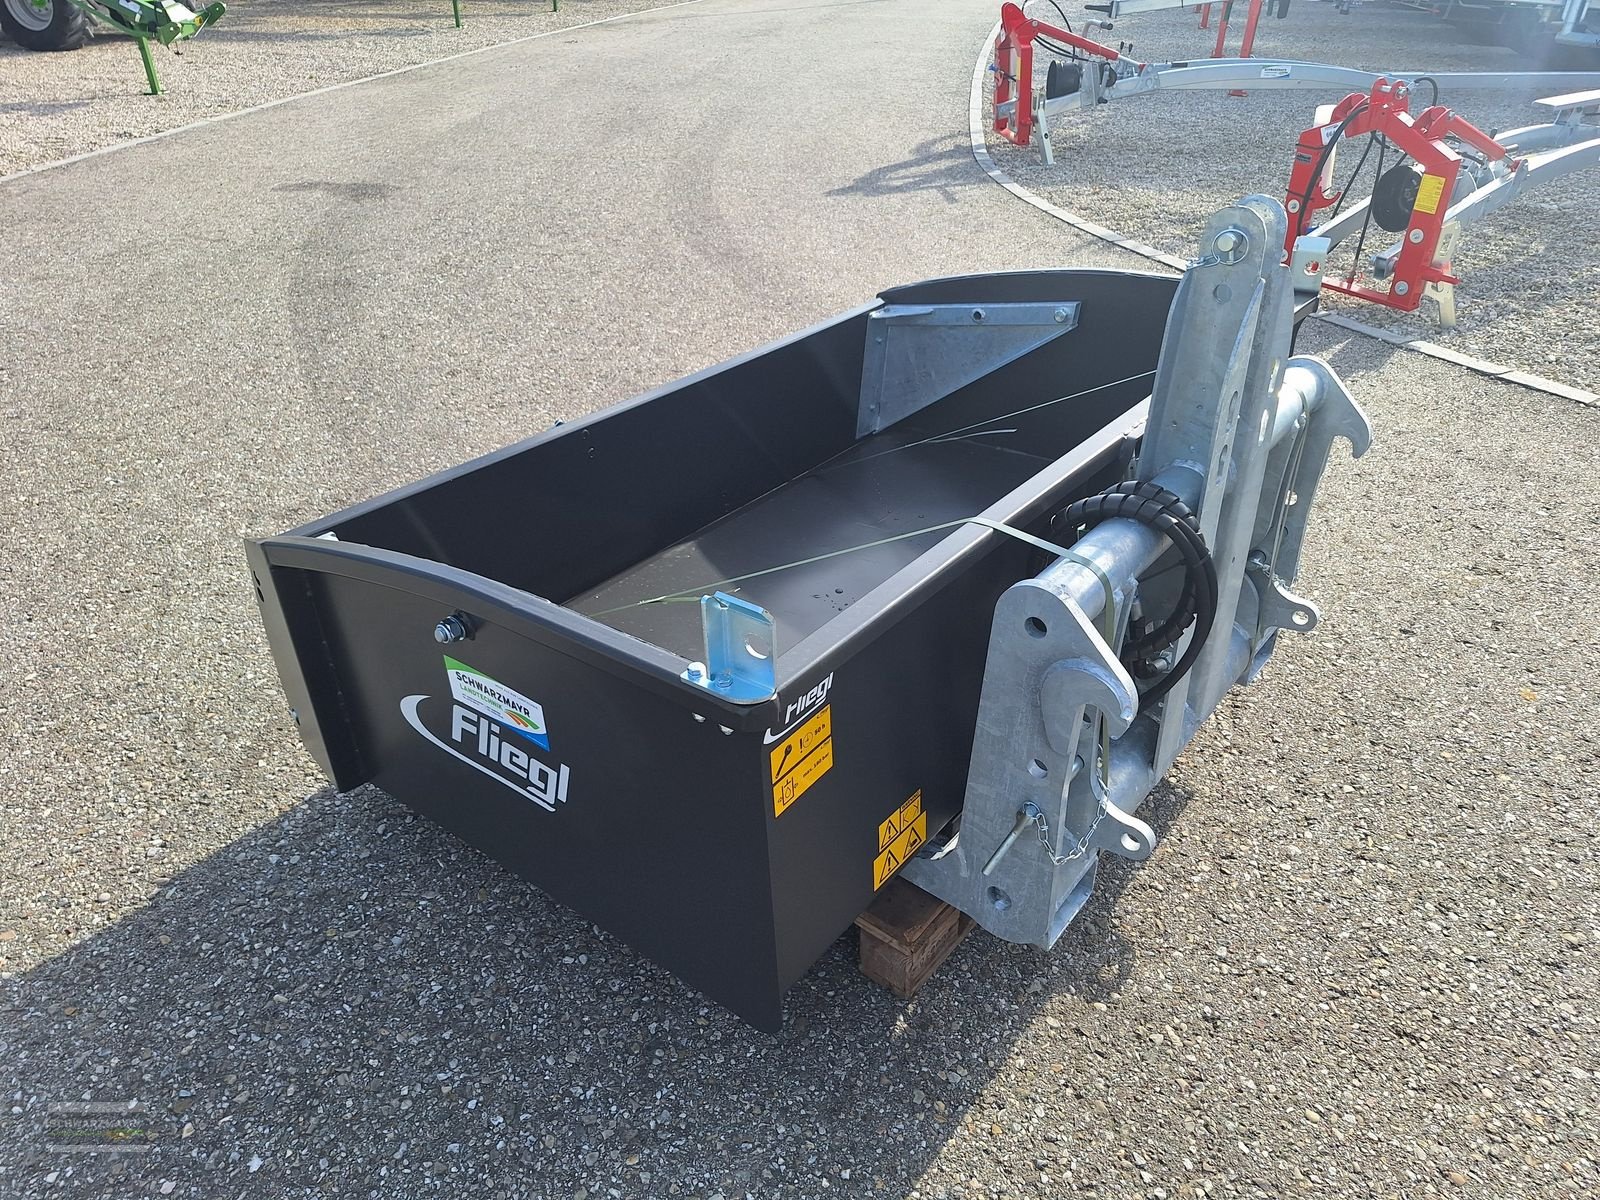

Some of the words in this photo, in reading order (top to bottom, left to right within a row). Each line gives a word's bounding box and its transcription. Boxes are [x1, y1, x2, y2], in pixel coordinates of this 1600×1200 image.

[455, 671, 531, 718] SCHWARZMAYR
[459, 683, 504, 712] LANDTECHNIK
[452, 704, 571, 805] Fliegl
